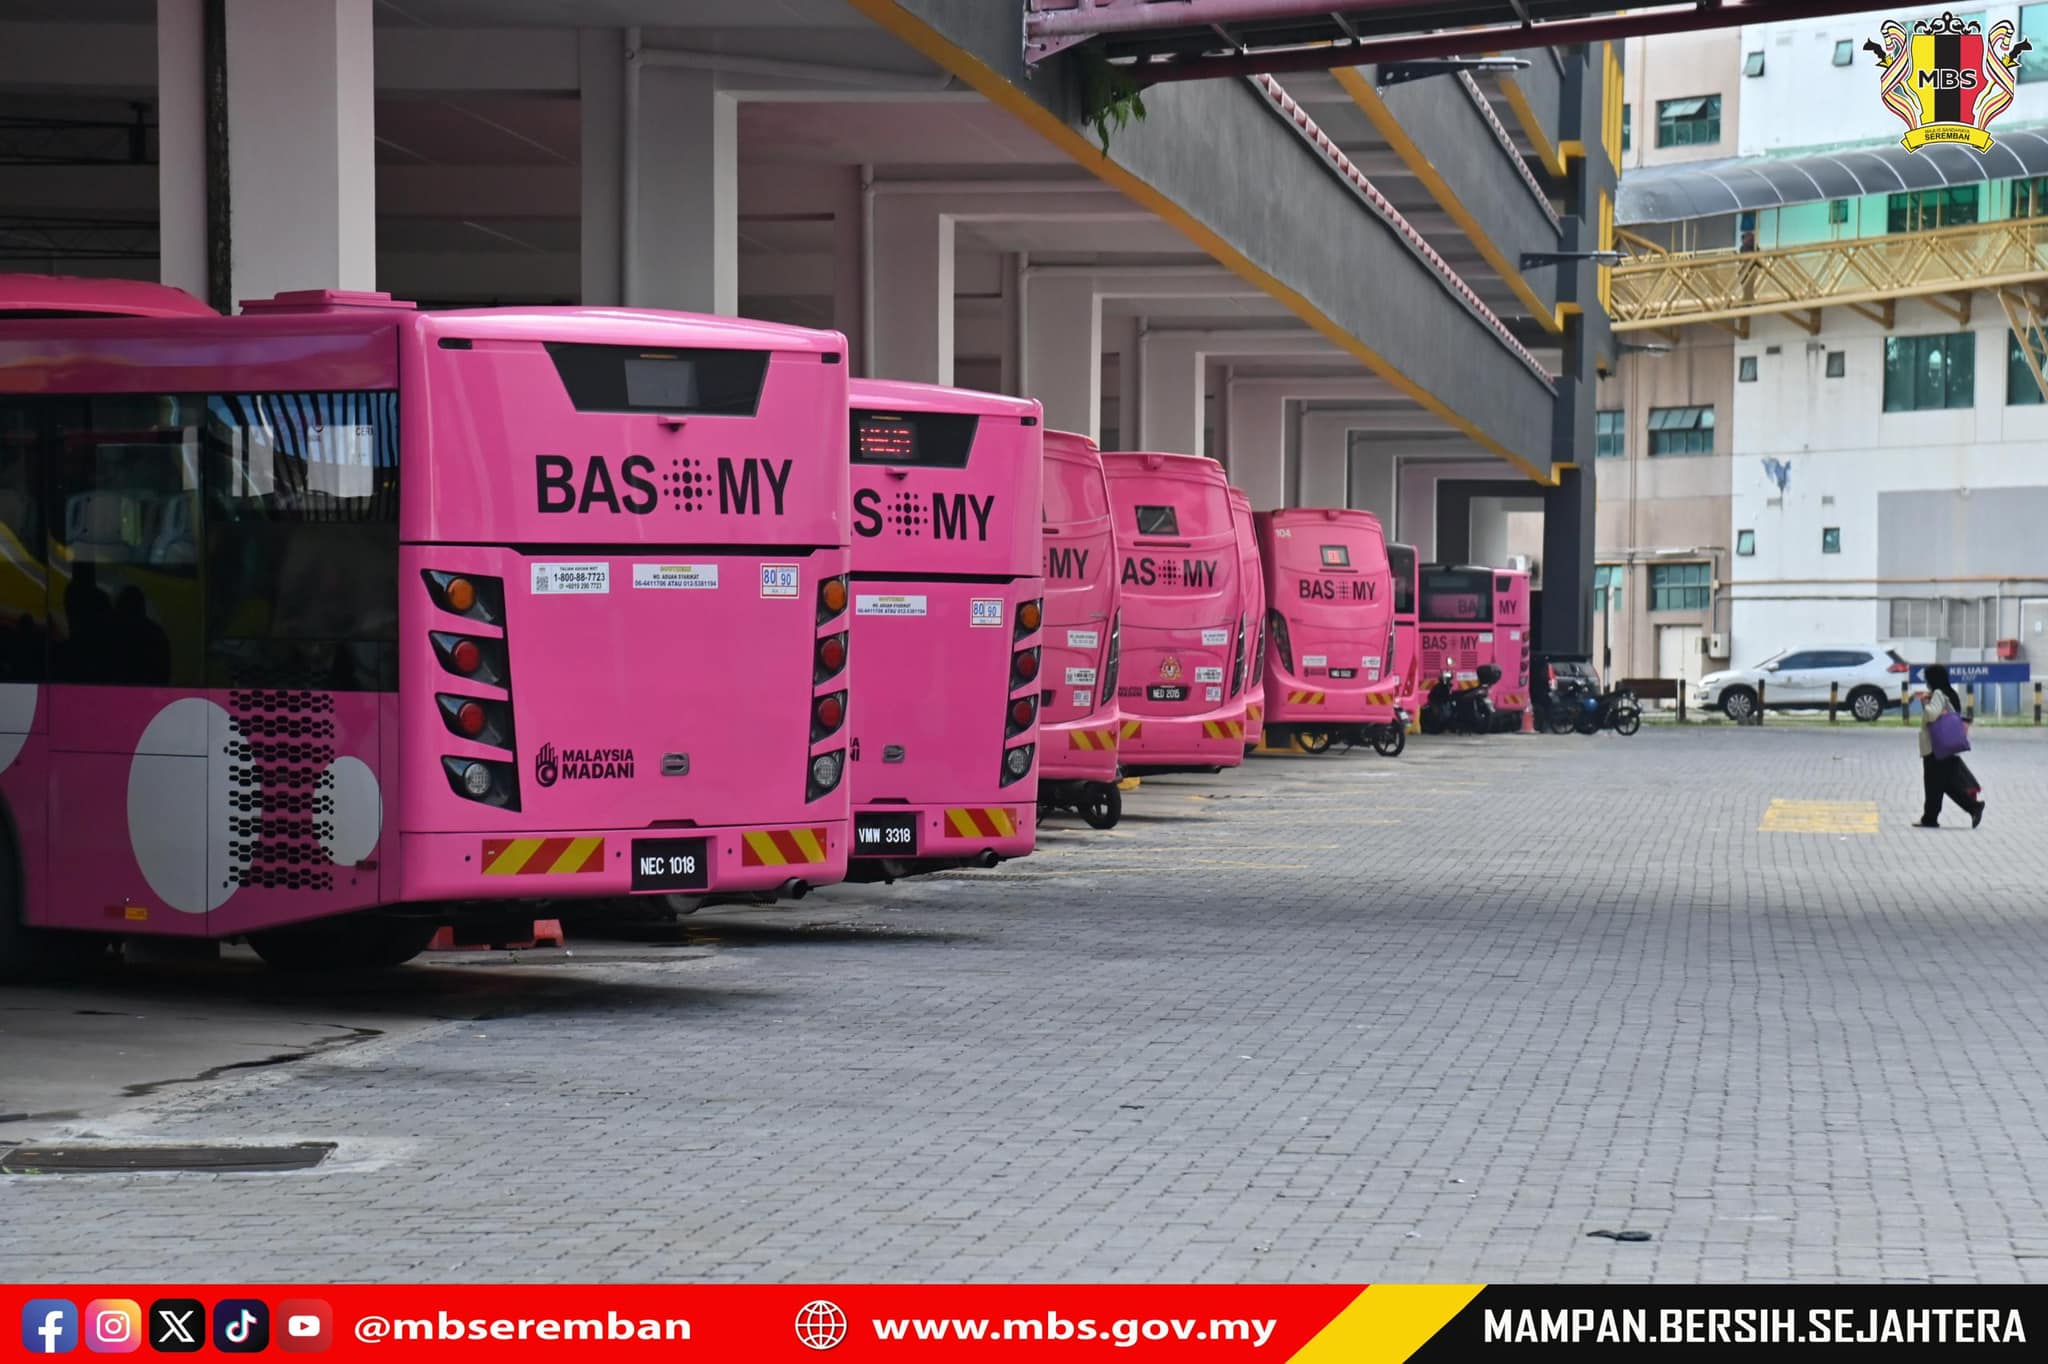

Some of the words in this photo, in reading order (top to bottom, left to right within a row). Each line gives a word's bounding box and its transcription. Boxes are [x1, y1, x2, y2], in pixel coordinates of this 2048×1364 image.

[535, 454, 658, 514] BAS
[717, 457, 793, 515] MY
[932, 492, 995, 541] MY
[1050, 548, 1089, 580] MY
[554, 572, 606, 582] 1-800-88-7723
[764, 569, 776, 584] 80
[780, 573, 791, 586] 90
[1184, 560, 1218, 587] MY
[1299, 579, 1335, 600] BAS
[1353, 581, 1376, 601] MY
[973, 603, 984, 615] 80
[1499, 600, 1517, 615] MY
[1422, 635, 1447, 650] BAS
[1460, 635, 1479, 650] MY
[1949, 666, 1989, 676] KELUAR
[562, 749, 634, 763] MALAYSIA
[562, 763, 634, 779] MADANI
[858, 828, 881, 843] VMW
[885, 828, 911, 843] 3318
[640, 857, 665, 876] NEC
[669, 856, 695, 875] 1018
